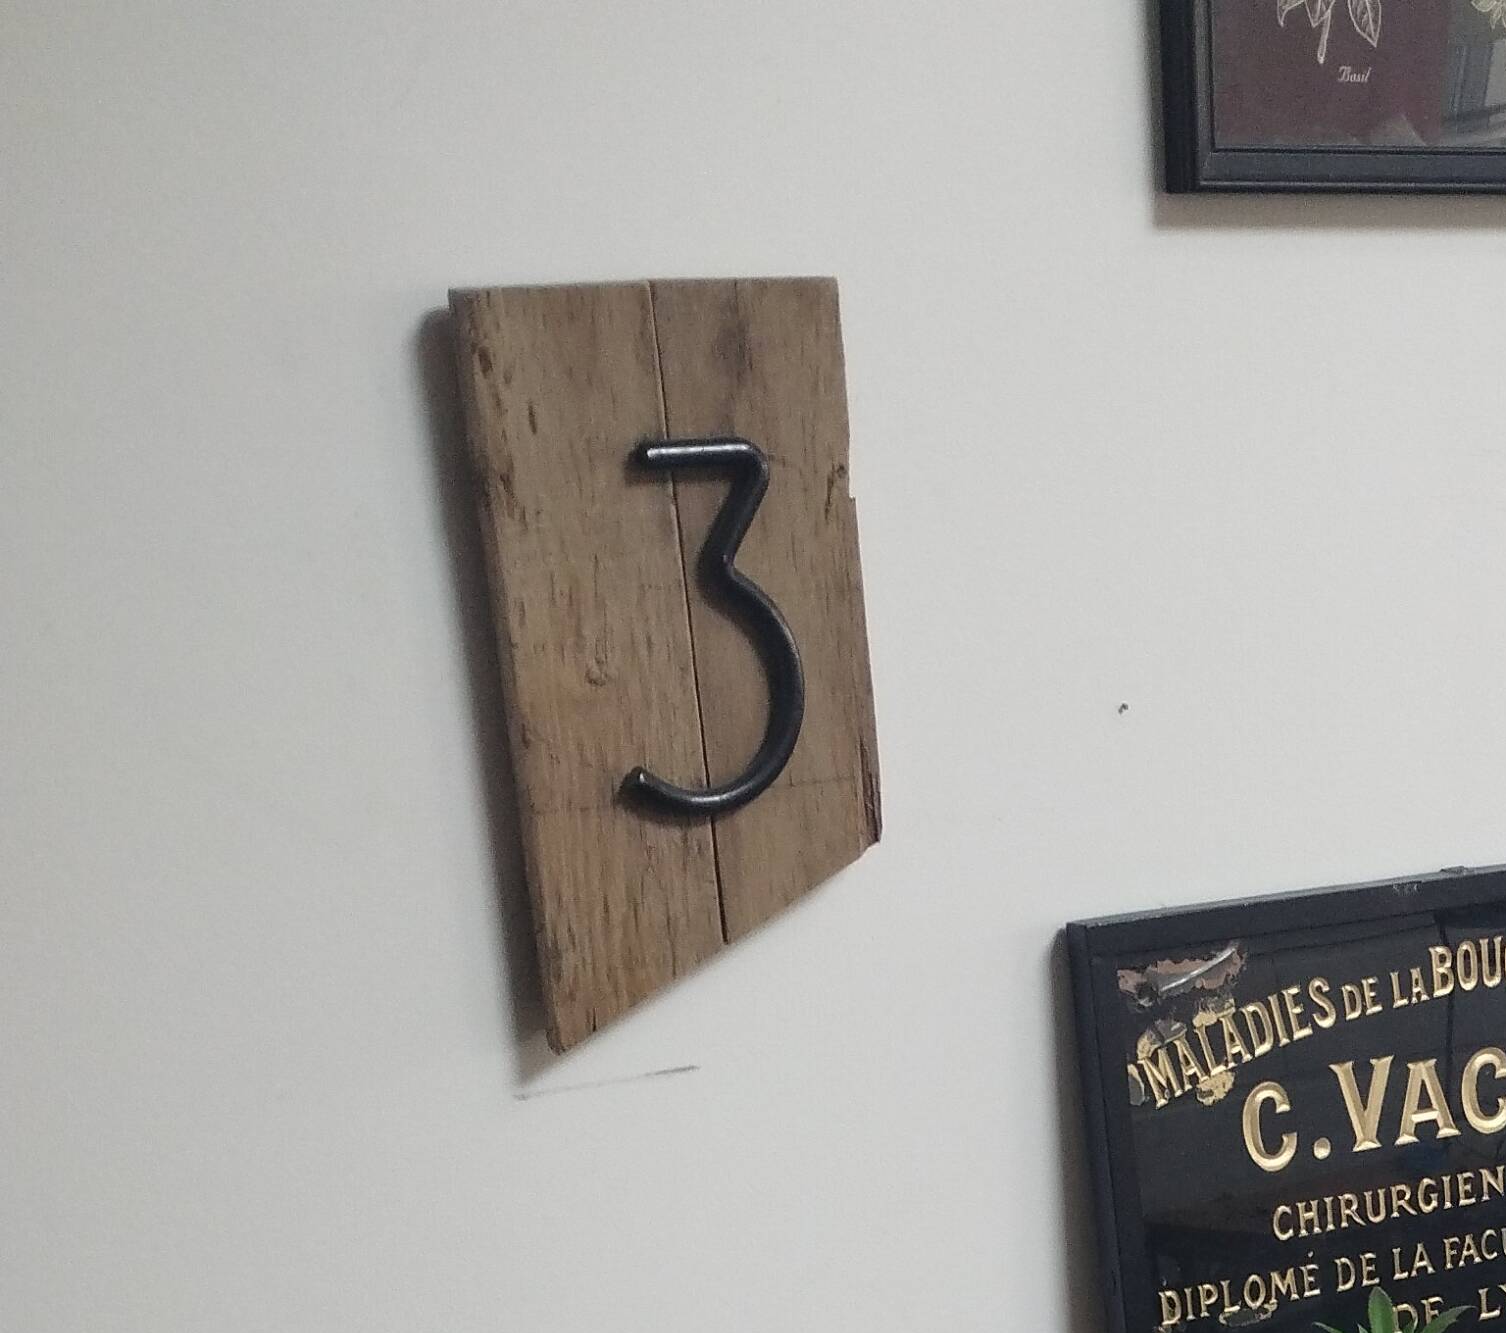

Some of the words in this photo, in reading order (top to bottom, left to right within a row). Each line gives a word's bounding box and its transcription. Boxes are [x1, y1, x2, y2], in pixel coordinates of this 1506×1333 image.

[1338, 65, 1372, 83] Basil
[628, 437, 805, 816] 3
[1137, 977, 1338, 1110] MALADIES
[1342, 976, 1383, 1021] DE
[1390, 967, 1431, 1009] LA
[1272, 1165, 1506, 1242] CHIRURGIEN
[1158, 1250, 1322, 1327] DIPLOMÉ
[1334, 1252, 1381, 1294] DE
[1391, 1242, 1436, 1282] LA
